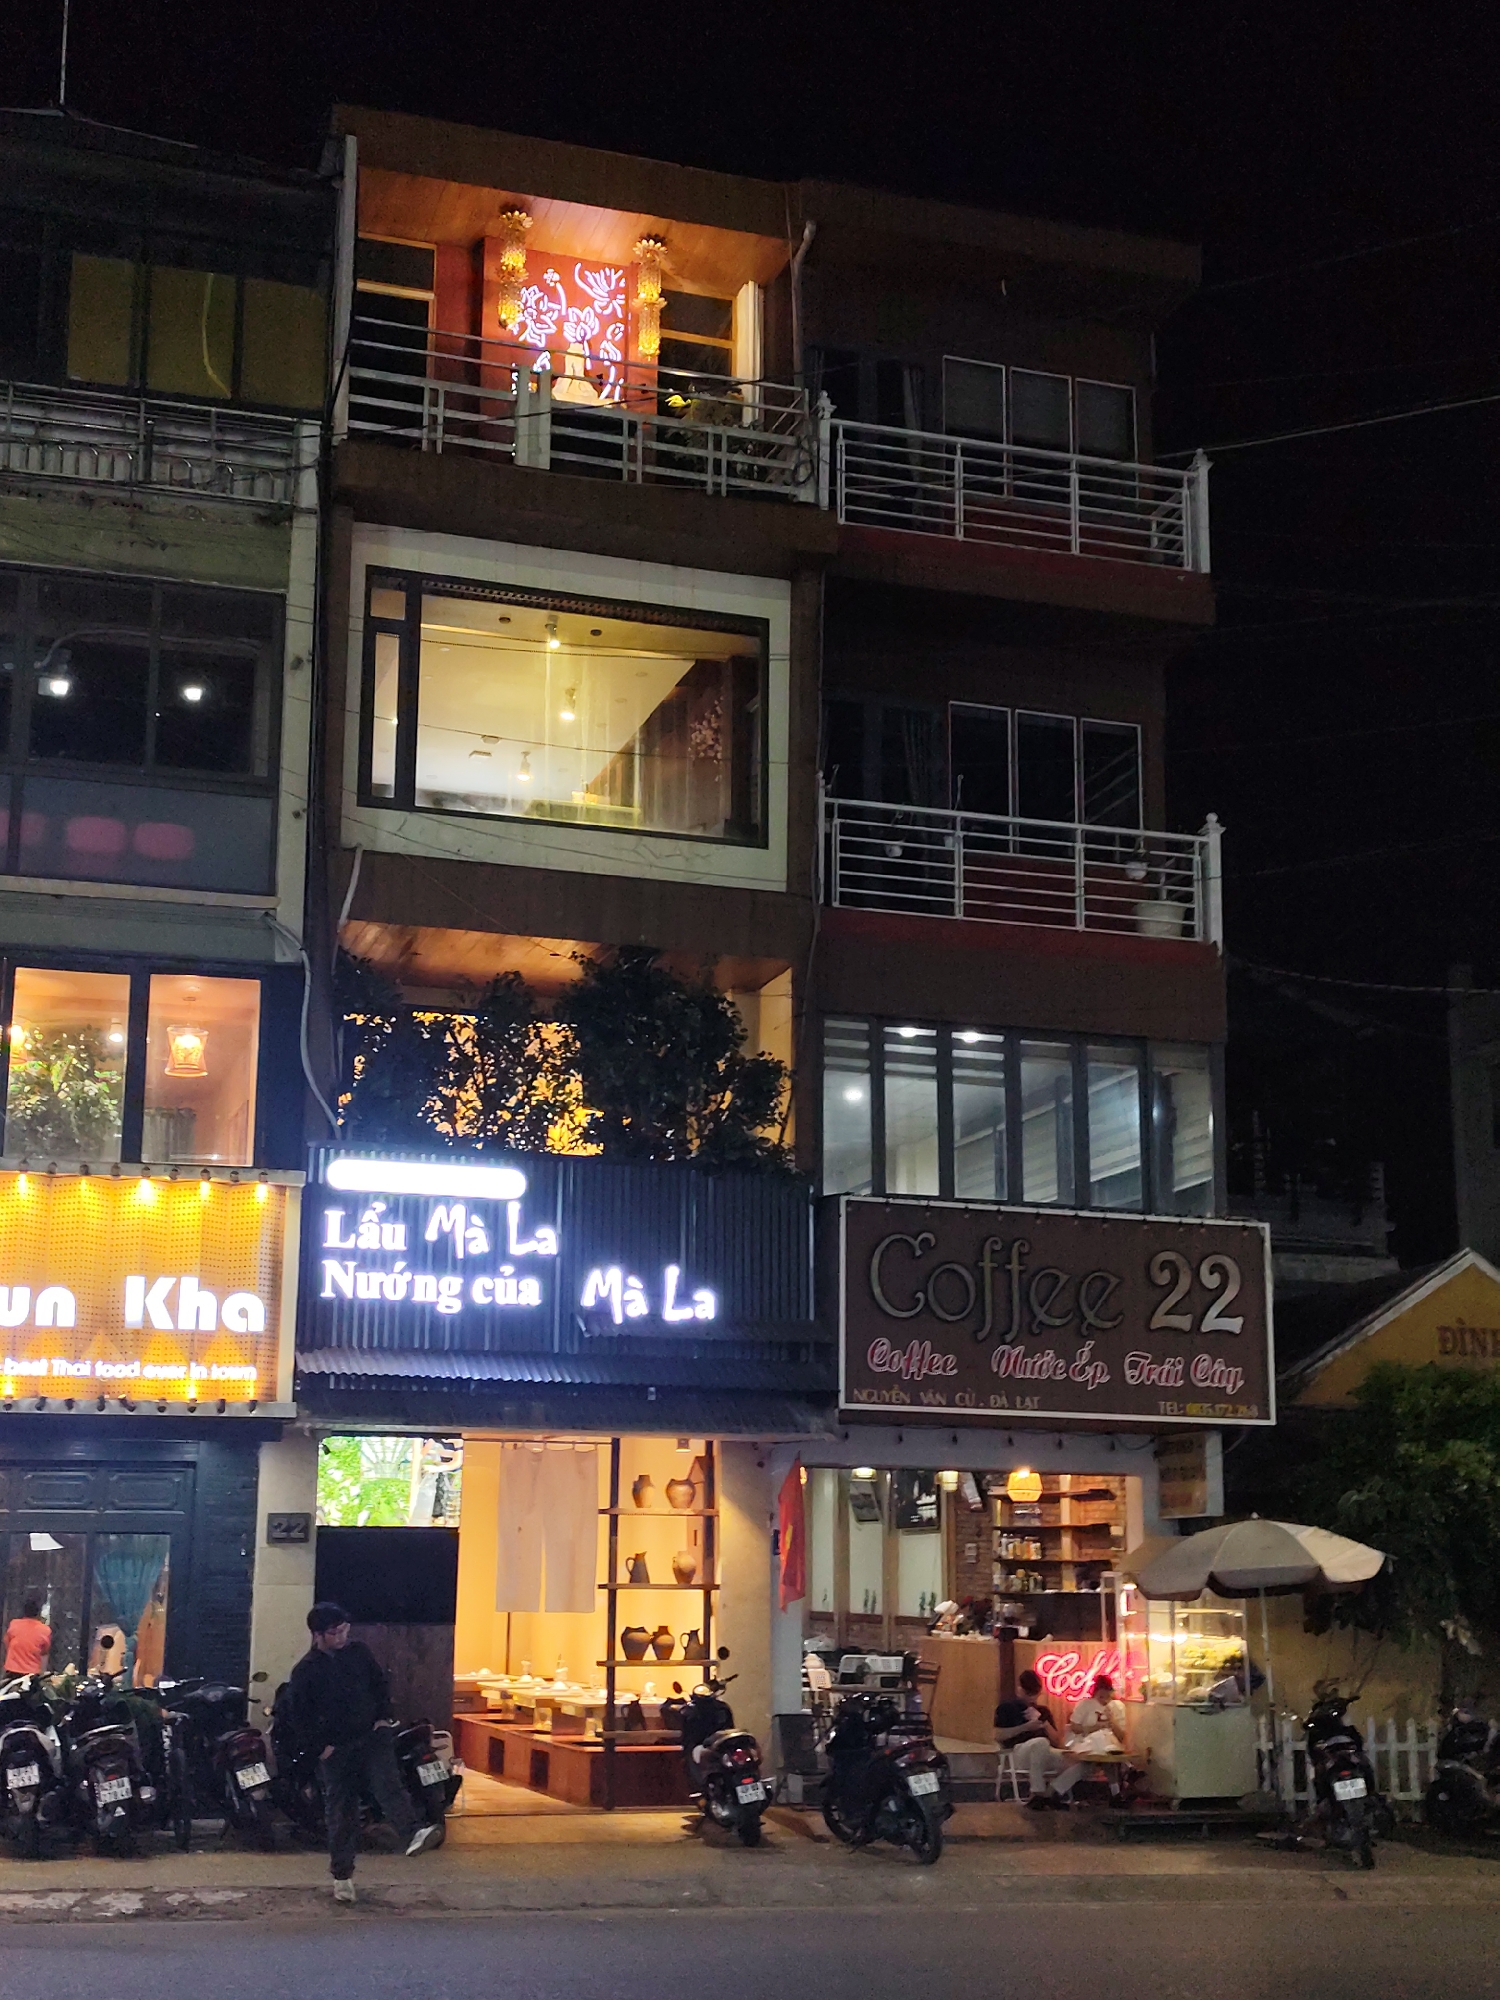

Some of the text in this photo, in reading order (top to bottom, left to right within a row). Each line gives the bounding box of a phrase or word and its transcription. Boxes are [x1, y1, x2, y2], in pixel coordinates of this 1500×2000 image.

[323, 1201, 558, 1259] Lẩu Mà La
[124, 1275, 266, 1333] Kha
[320, 1259, 716, 1325] Nướng của Mà La
[870, 1232, 1244, 1343] Coffee 22
[51, 1358, 92, 1378] Thai
[95, 1361, 141, 1379] food
[210, 1363, 258, 1381] town
[867, 1337, 959, 1381] Coffee
[1124, 1351, 1185, 1388] Trái
[1190, 1353, 1246, 1395] Cây
[271, 1517, 305, 1539] 22
